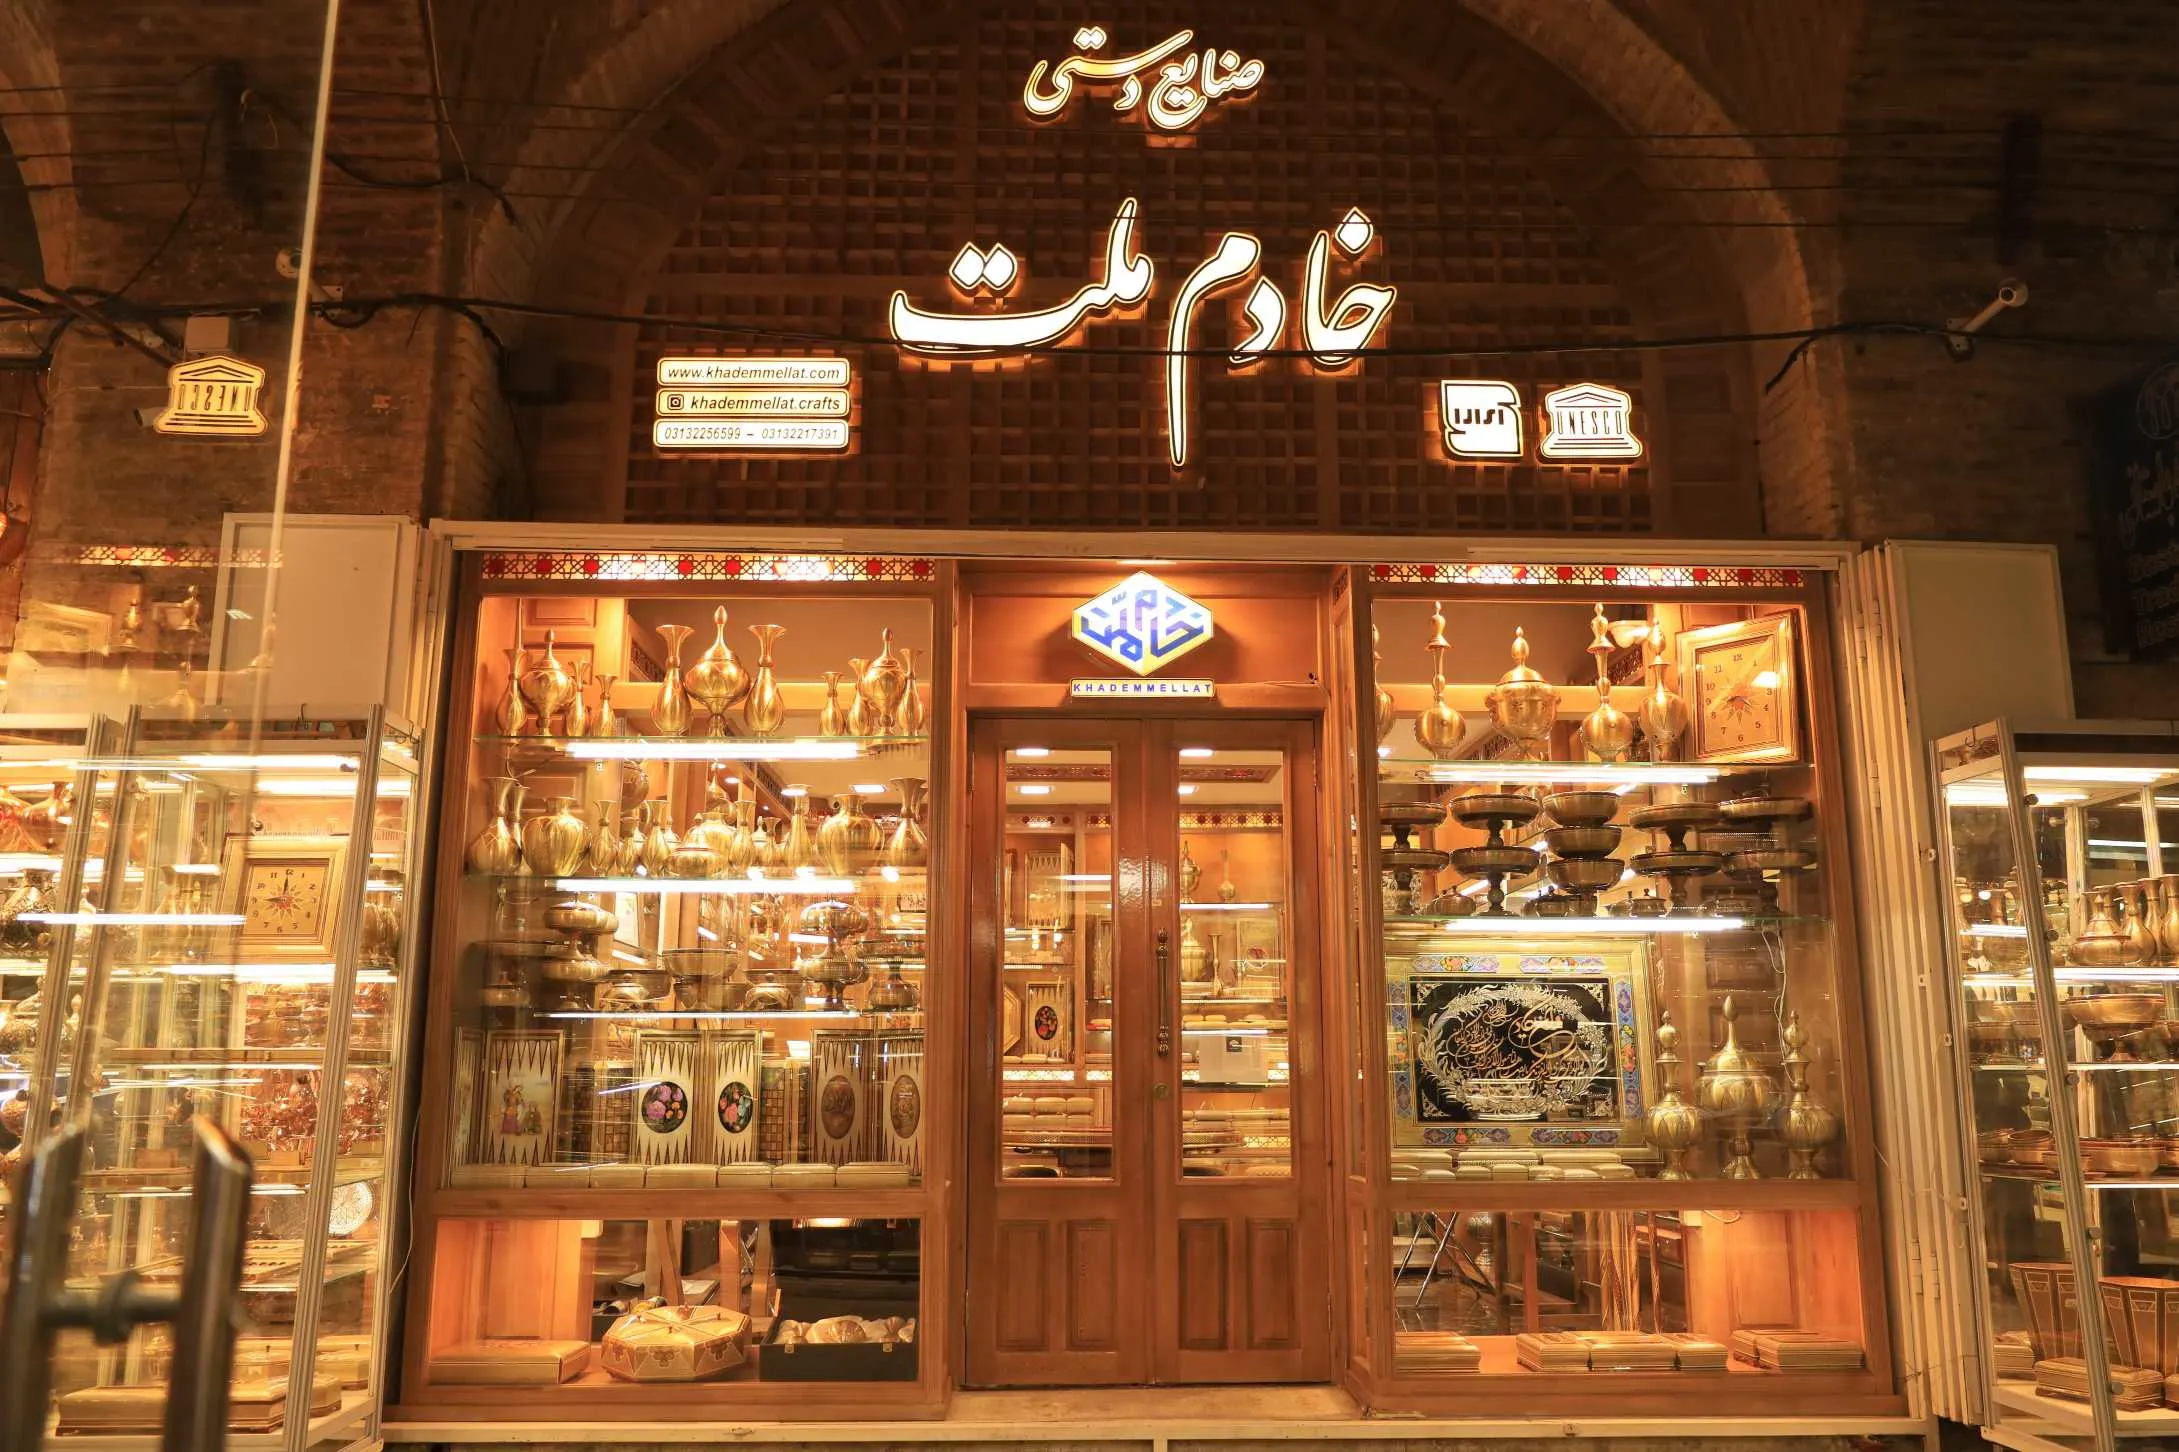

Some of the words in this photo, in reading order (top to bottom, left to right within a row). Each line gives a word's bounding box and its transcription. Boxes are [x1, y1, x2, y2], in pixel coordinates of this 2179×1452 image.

[1023, 26, 1194, 115] دستی
[1148, 48, 1265, 129] صنایع
[889, 196, 1154, 354] ملت
[1166, 206, 1397, 467] خادم
[667, 366, 840, 380] www.khademmellat.com
[690, 396, 840, 410] khademmellat.crafts
[664, 426, 741, 440] 03132256599
[761, 428, 837, 440] 03132217391
[1557, 410, 1623, 435] UNESCO
[1073, 683, 1212, 693] KHADEMMELLAT
